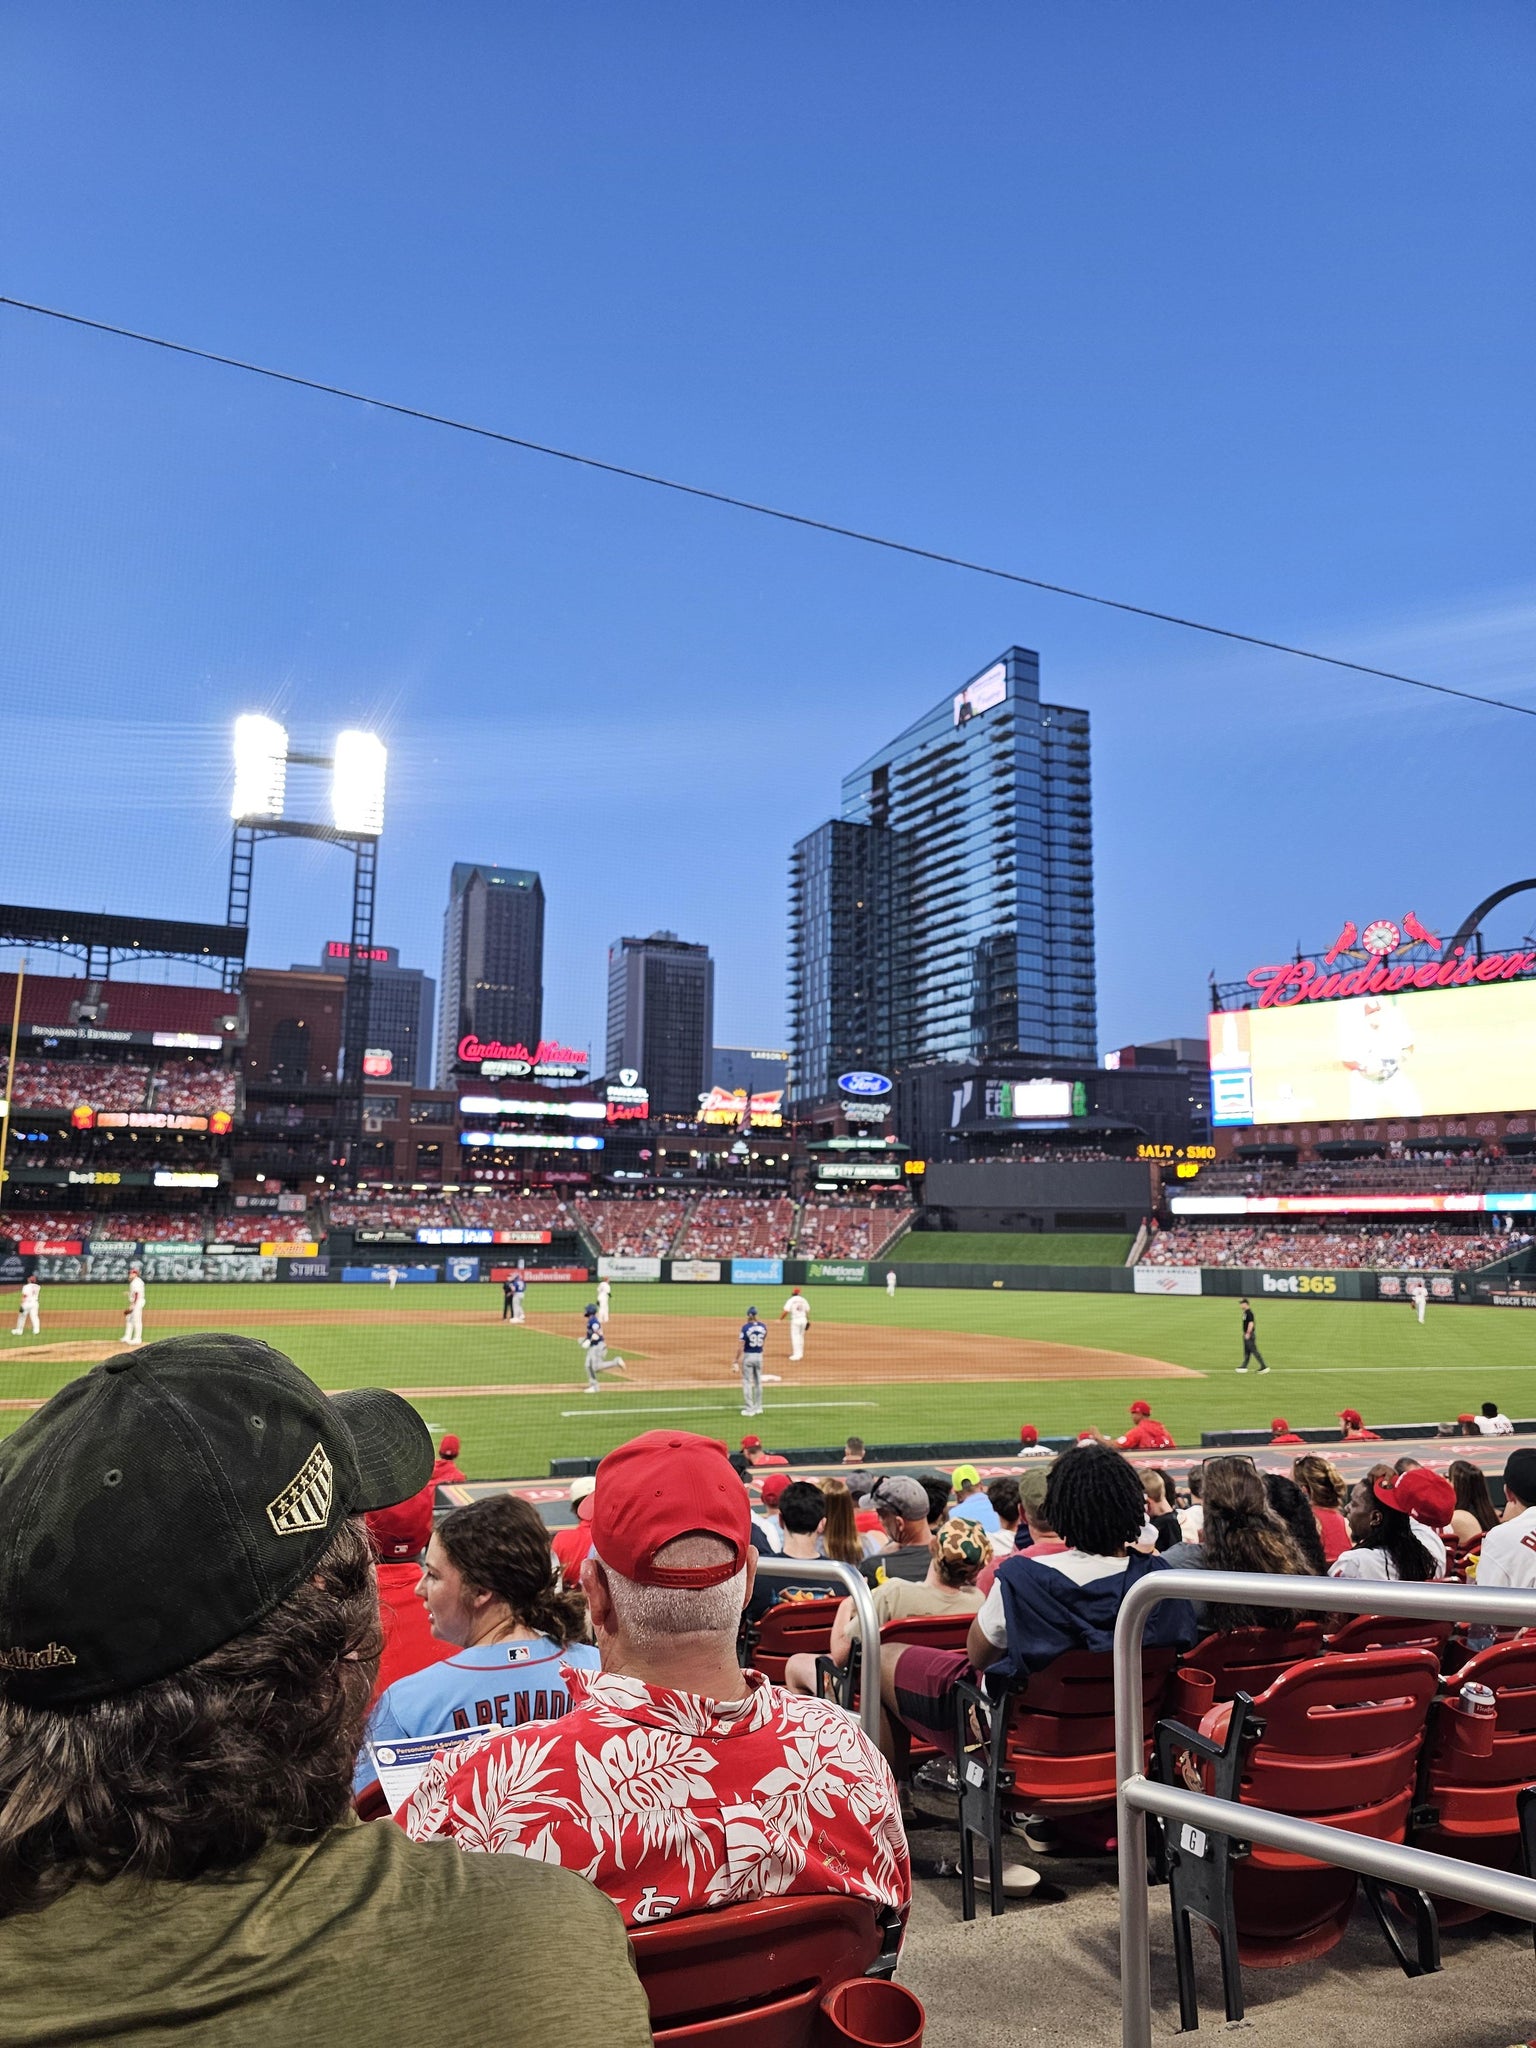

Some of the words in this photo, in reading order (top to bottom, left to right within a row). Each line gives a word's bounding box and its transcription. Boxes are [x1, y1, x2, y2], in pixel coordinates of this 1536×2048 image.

[328, 942, 388, 962] Hiton
[1247, 946, 1536, 1010] Budweiser
[458, 1034, 533, 1063] Cardinals
[527, 1040, 588, 1066] Nation
[751, 1051, 782, 1060] LARSON
[848, 1075, 881, 1090] Ford
[606, 1102, 649, 1122] Live!
[1137, 1144, 1174, 1158] SALT
[68, 1170, 121, 1184] bet365
[822, 1264, 866, 1277] National
[1262, 1273, 1337, 1293] bet365
[1493, 1295, 1520, 1305] BUSCH
[1189, 1829, 1197, 1848] G
